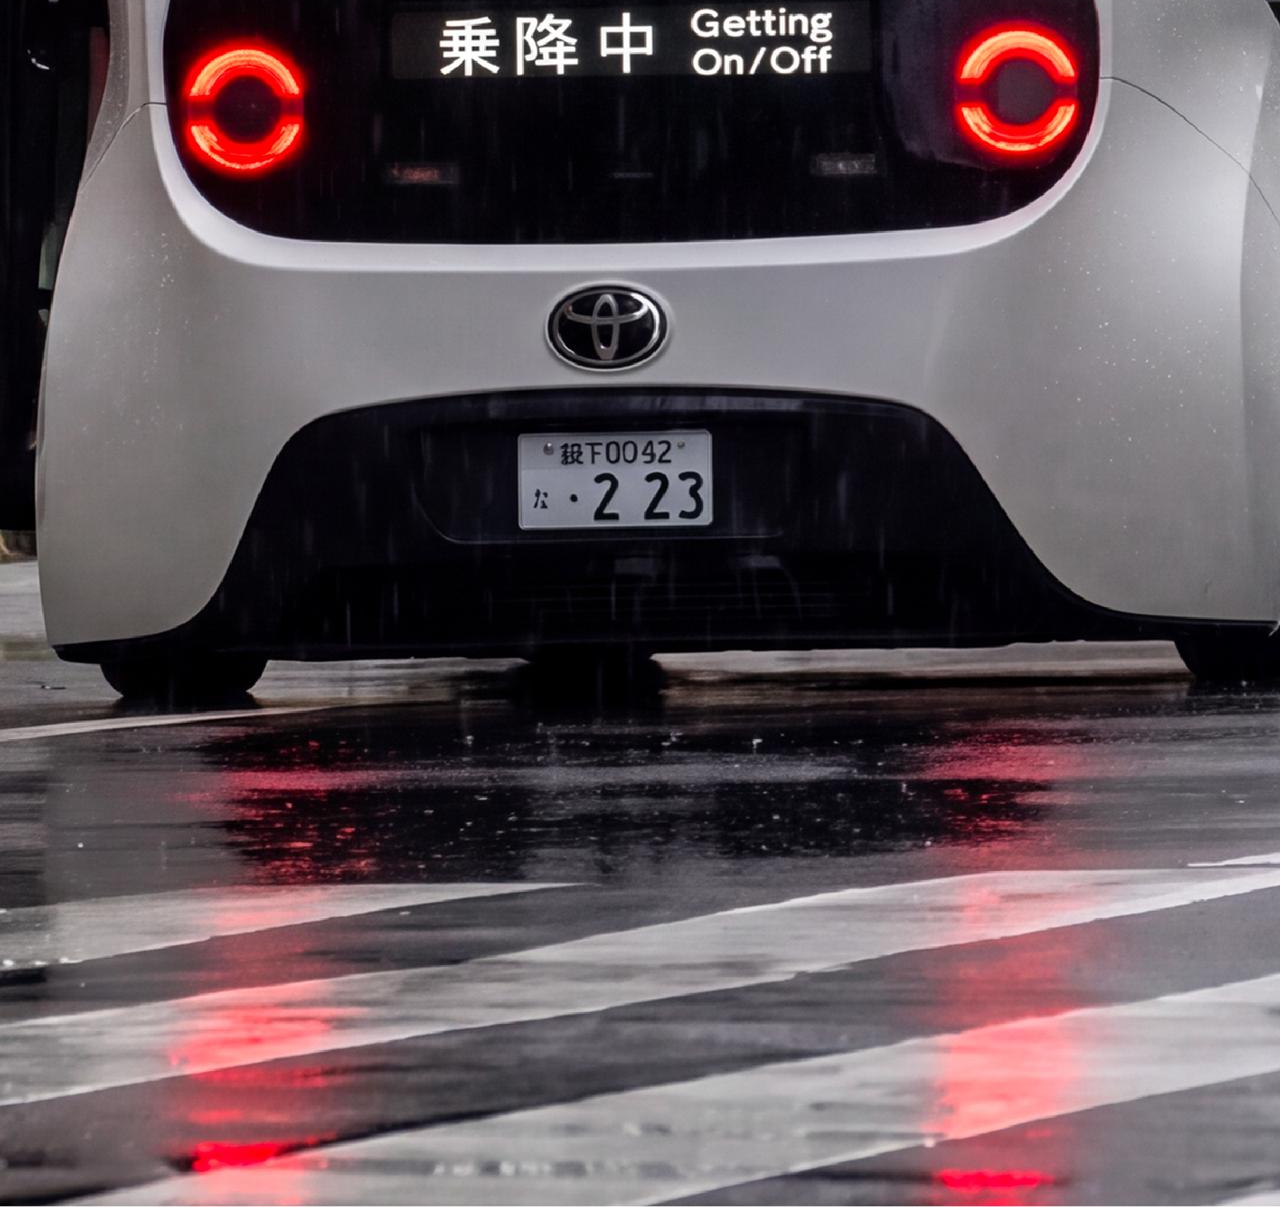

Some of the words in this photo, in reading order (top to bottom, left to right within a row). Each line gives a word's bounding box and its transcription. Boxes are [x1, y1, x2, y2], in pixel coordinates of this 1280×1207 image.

[690, 7, 833, 43] Getting
[439, 11, 654, 77] 乗降中
[691, 45, 833, 77] On/Off
